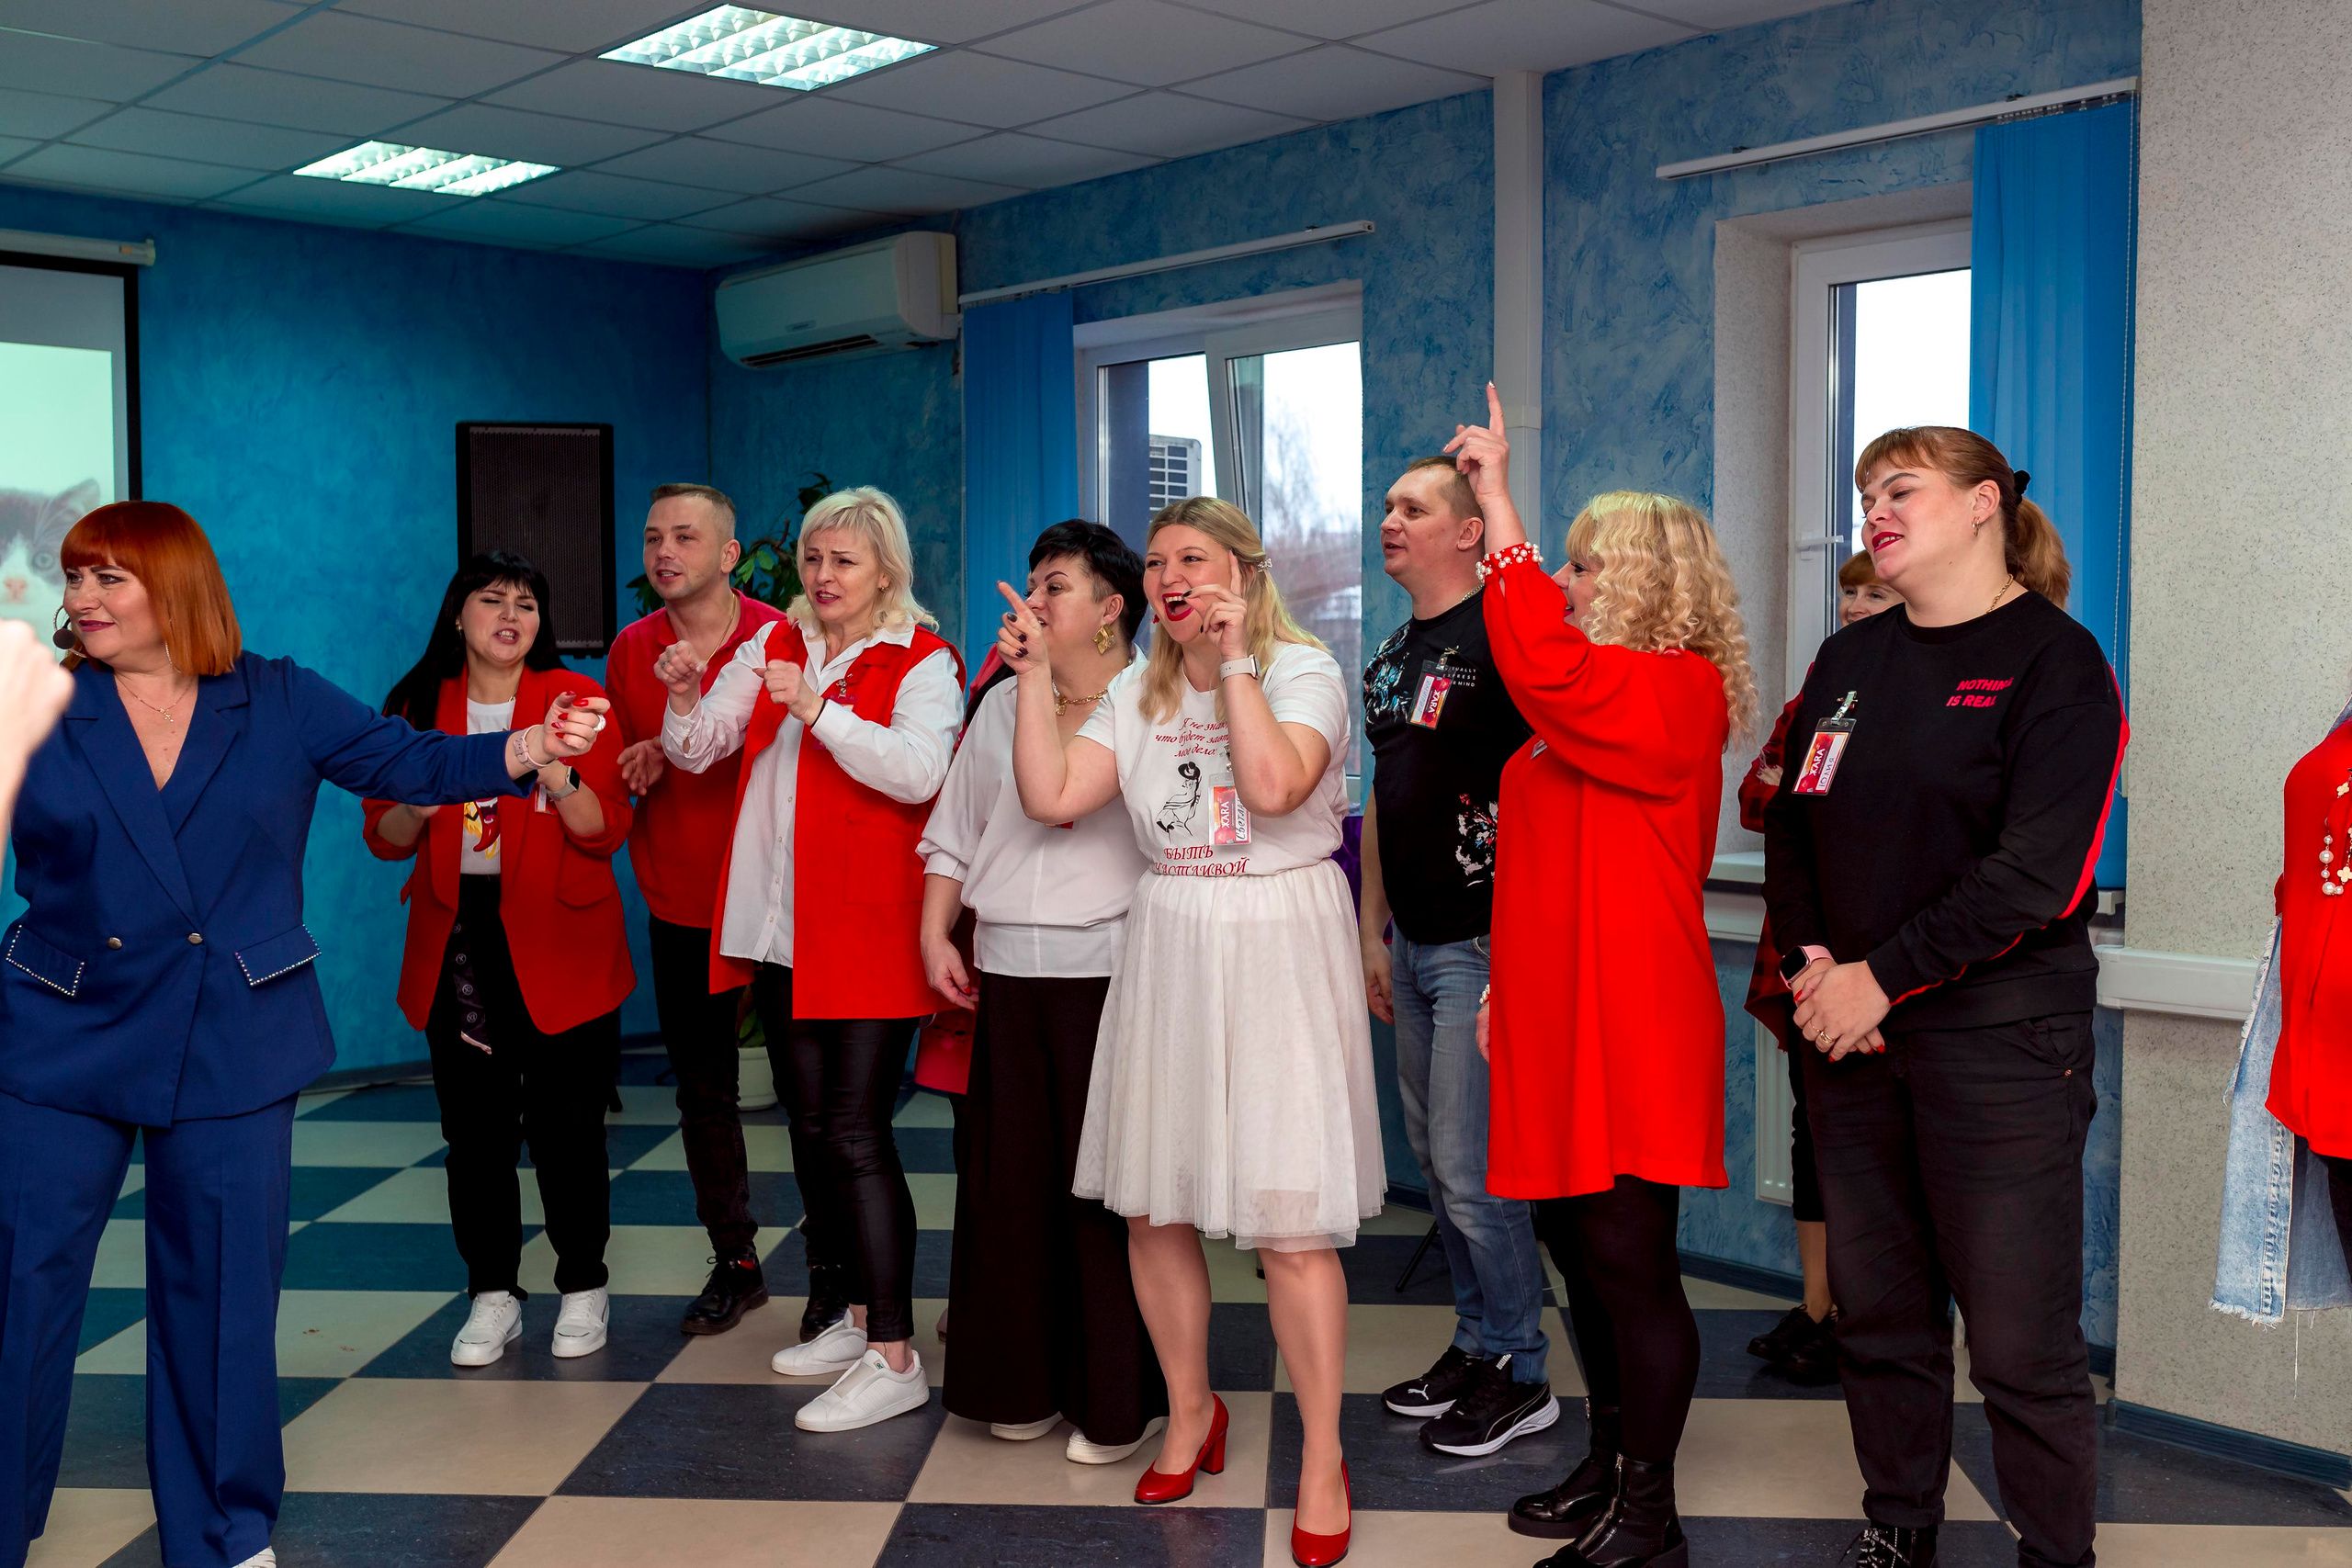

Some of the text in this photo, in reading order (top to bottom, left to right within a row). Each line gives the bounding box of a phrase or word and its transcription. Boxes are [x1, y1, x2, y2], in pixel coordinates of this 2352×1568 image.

[1946, 695, 1962, 706] IS
[1179, 717, 1193, 730] Я
[1190, 721, 1204, 729] не
[1155, 730, 1229, 746] что будет завт
[1236, 797, 1246, 840] Светла
[1164, 844, 1214, 860] БЫТЬ
[1155, 856, 1250, 876] ЧАСТЛИВОЙ
